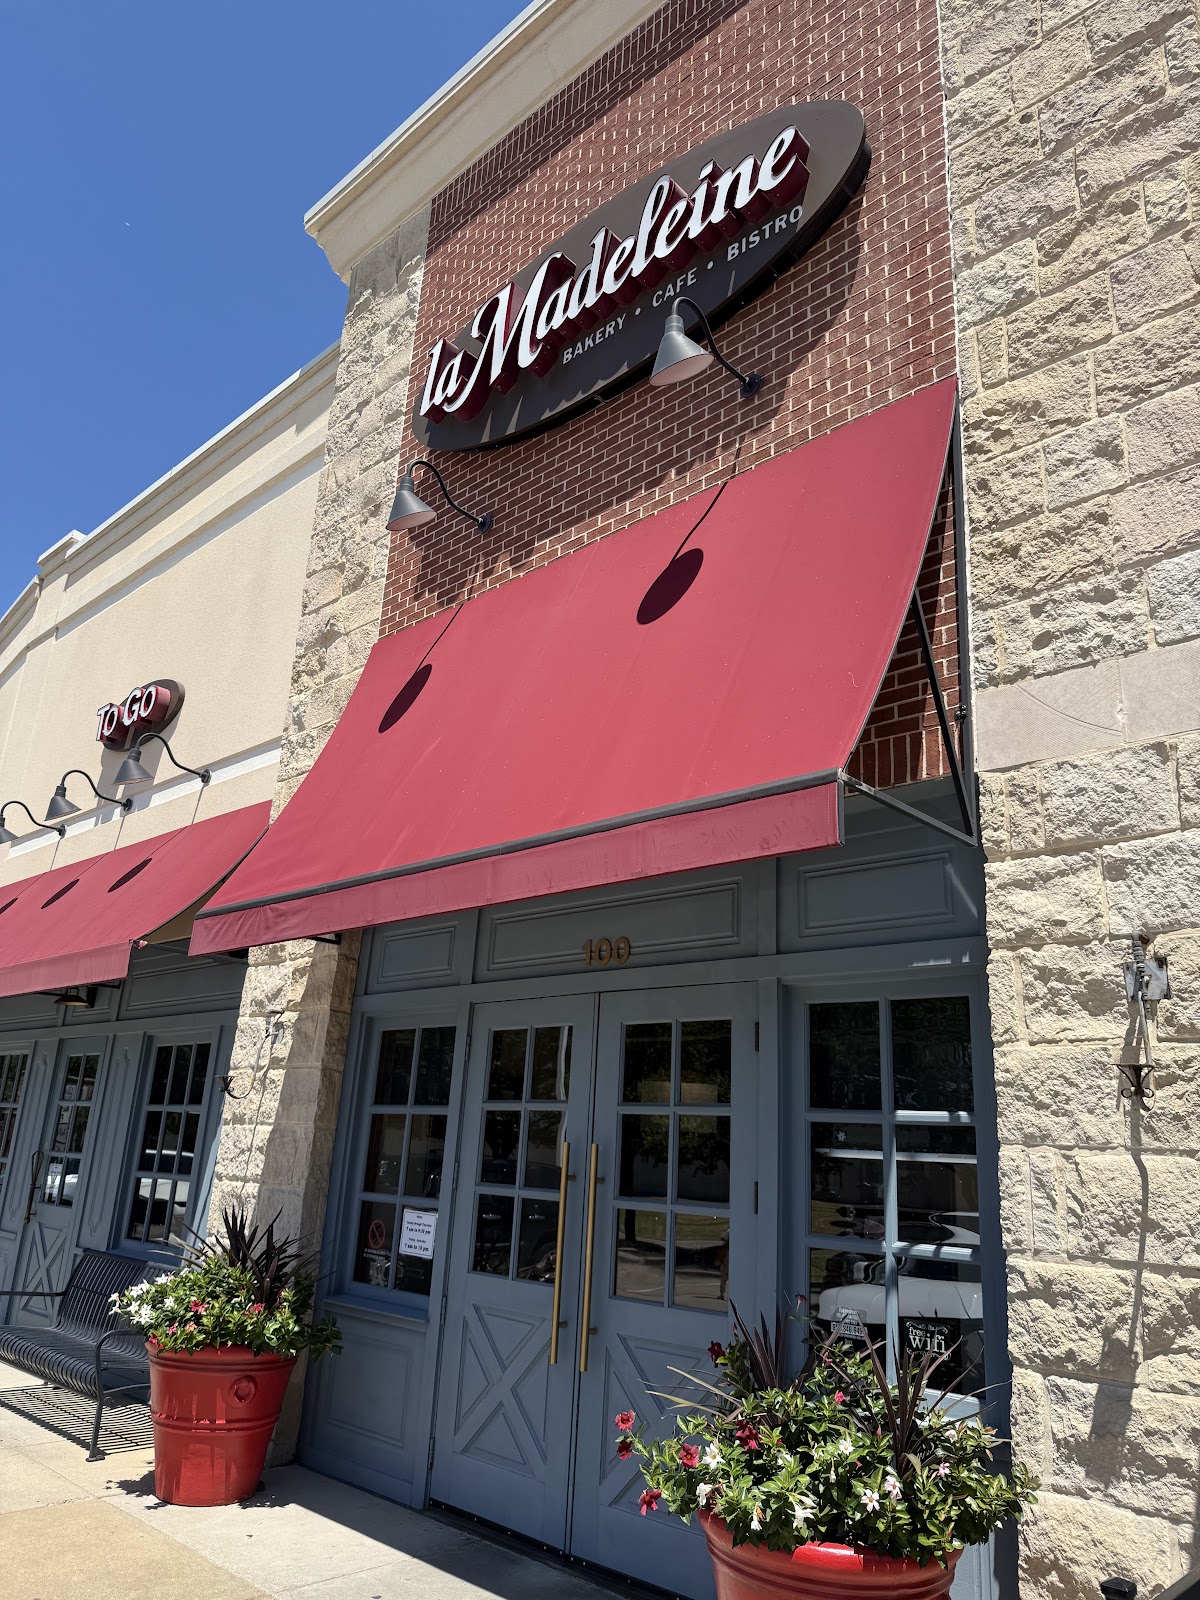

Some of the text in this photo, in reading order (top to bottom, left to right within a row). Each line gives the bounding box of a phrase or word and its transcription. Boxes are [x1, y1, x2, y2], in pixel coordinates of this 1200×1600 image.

[418, 125, 798, 417] la Madeleine
[562, 204, 804, 366] BAKERY CAFE BISTRO
[96, 684, 158, 741] TO GO
[582, 936, 631, 968] 100
[908, 1326, 926, 1337] free
